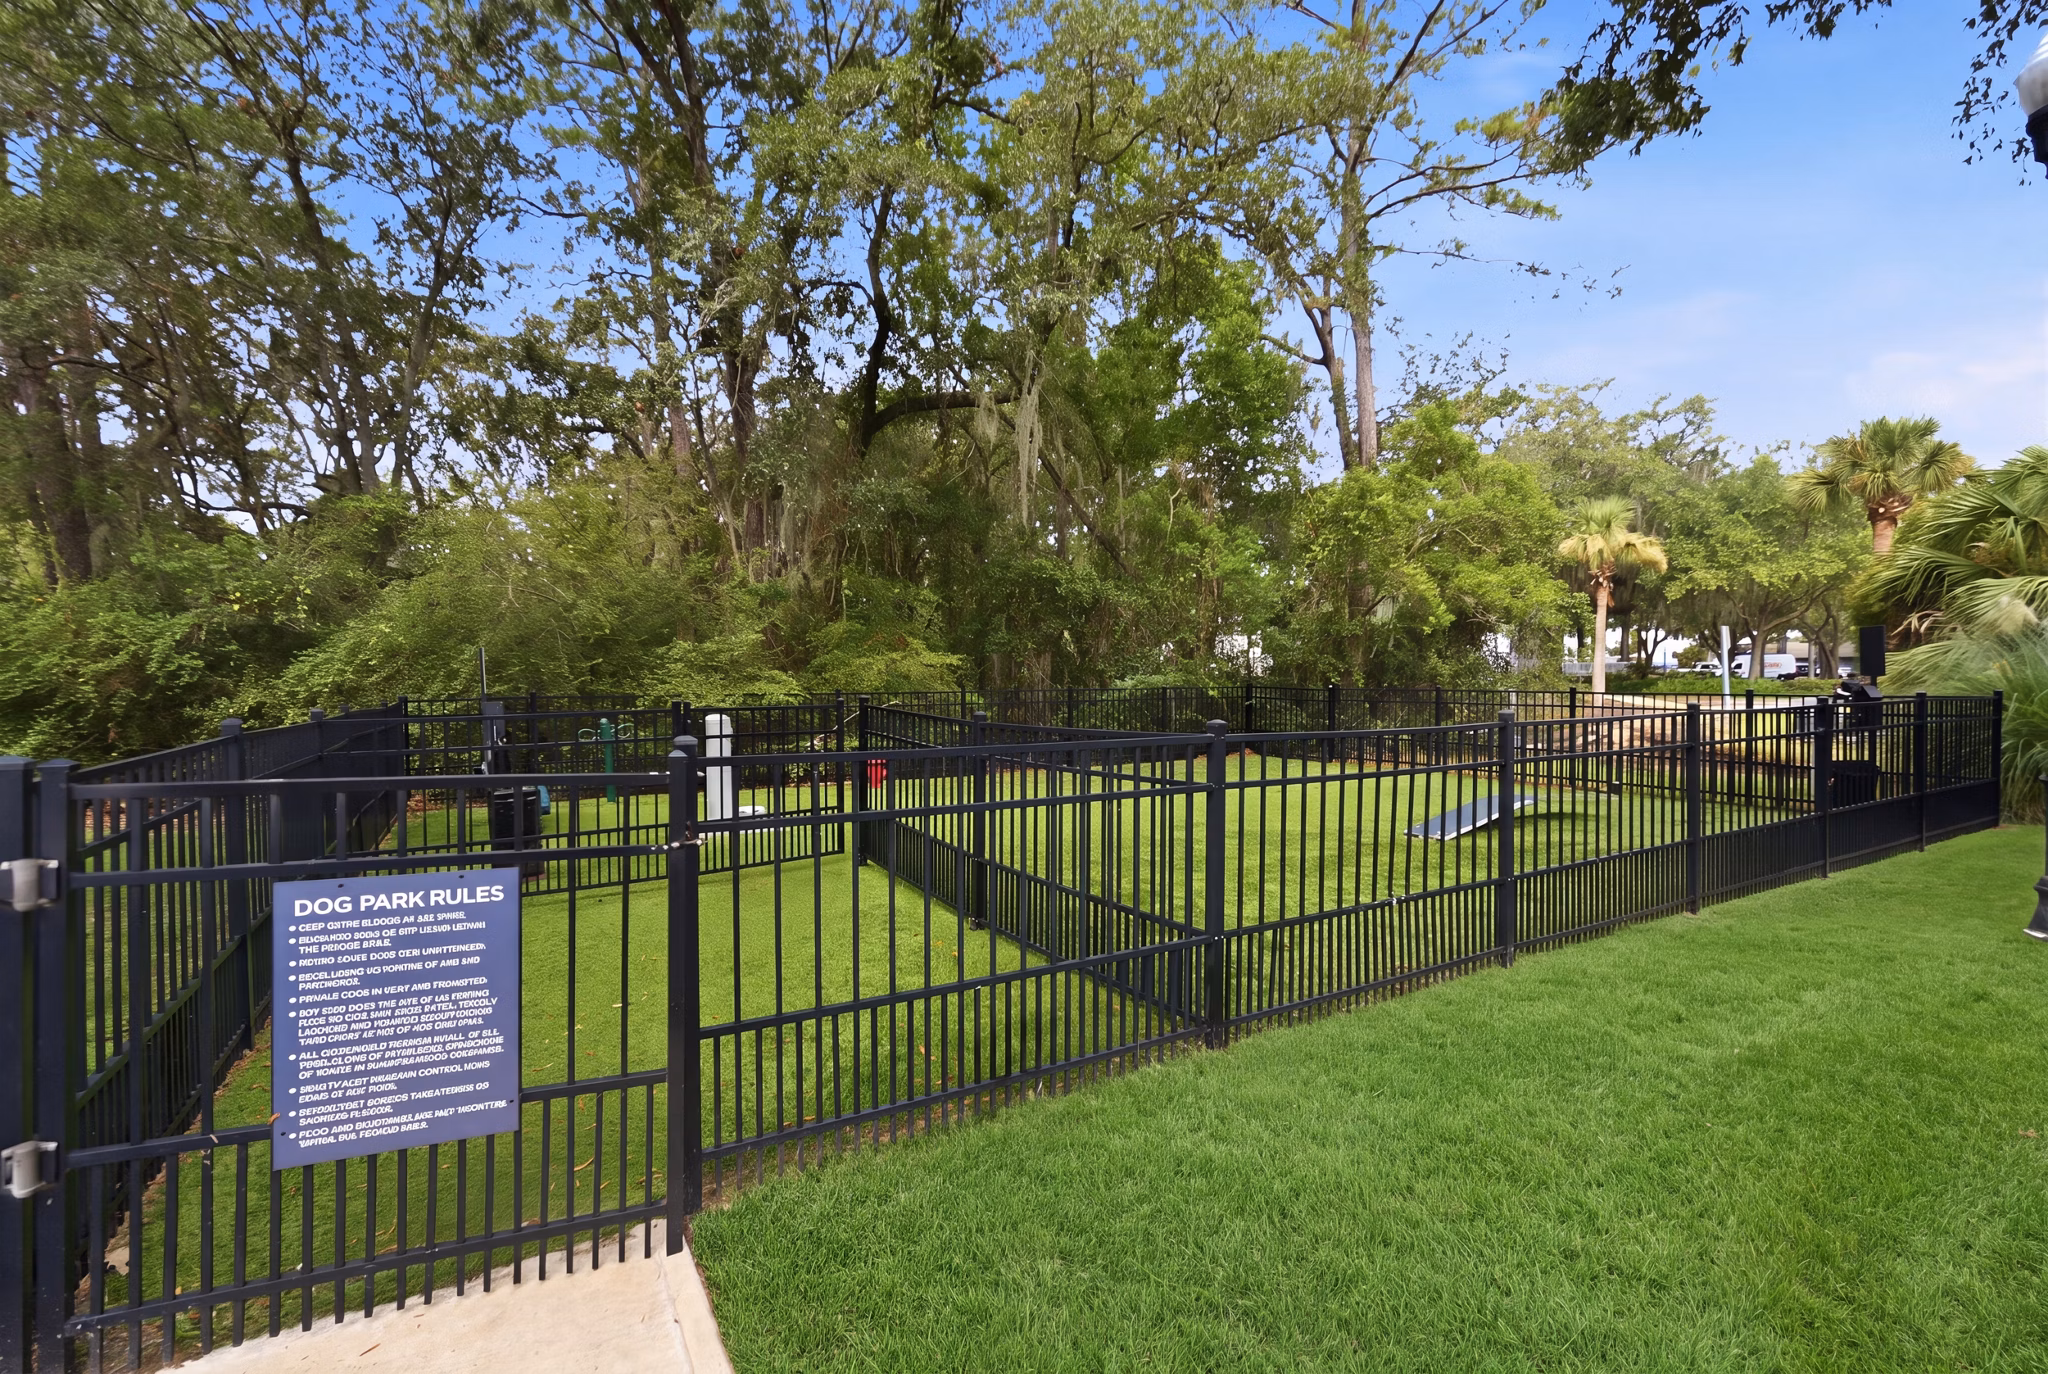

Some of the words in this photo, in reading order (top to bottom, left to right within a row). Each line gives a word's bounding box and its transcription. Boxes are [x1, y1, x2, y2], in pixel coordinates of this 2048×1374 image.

[294, 896, 351, 916] DOG
[360, 891, 424, 910] PARK
[430, 885, 503, 905] RULES
[298, 945, 318, 953] THE
[424, 960, 438, 968] OF
[371, 987, 381, 995] IN
[348, 1002, 375, 1011] DOES
[420, 995, 432, 1003] OF
[298, 1051, 318, 1059] ALL
